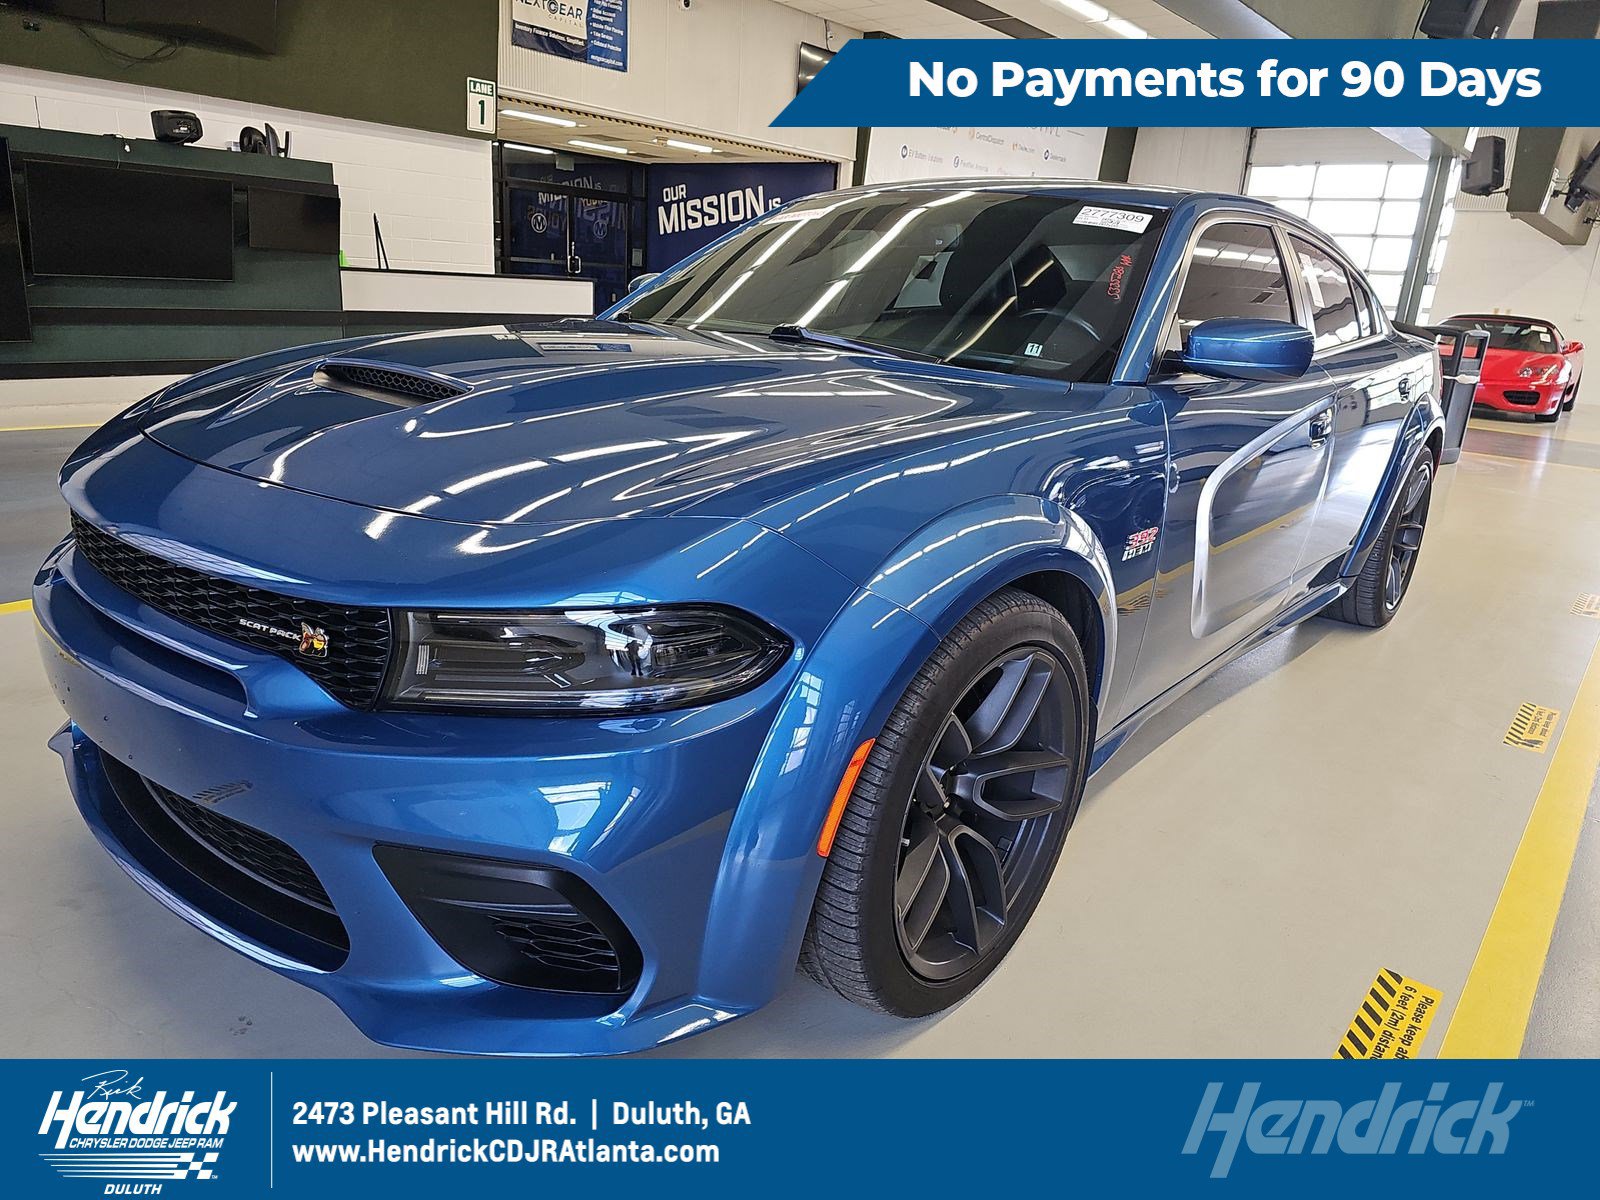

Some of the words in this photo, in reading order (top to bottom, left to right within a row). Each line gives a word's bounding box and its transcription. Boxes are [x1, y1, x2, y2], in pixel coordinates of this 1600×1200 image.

[548, 14, 584, 28] CAPITAL
[470, 82, 493, 95] LANE
[478, 100, 485, 125] 1
[663, 184, 687, 203] OUR
[658, 186, 764, 235] MISSION
[1082, 208, 1144, 223] 2777309
[1127, 526, 1159, 550] 392
[1122, 542, 1153, 562] HEMI
[239, 618, 269, 632] SCAT
[269, 627, 302, 641] PACK
[1404, 985, 1418, 994] 6
[1395, 992, 1415, 1010] feet
[1411, 995, 1435, 1024] Please
[1384, 1008, 1407, 1031] (2m)
[1399, 1023, 1422, 1047] keep
